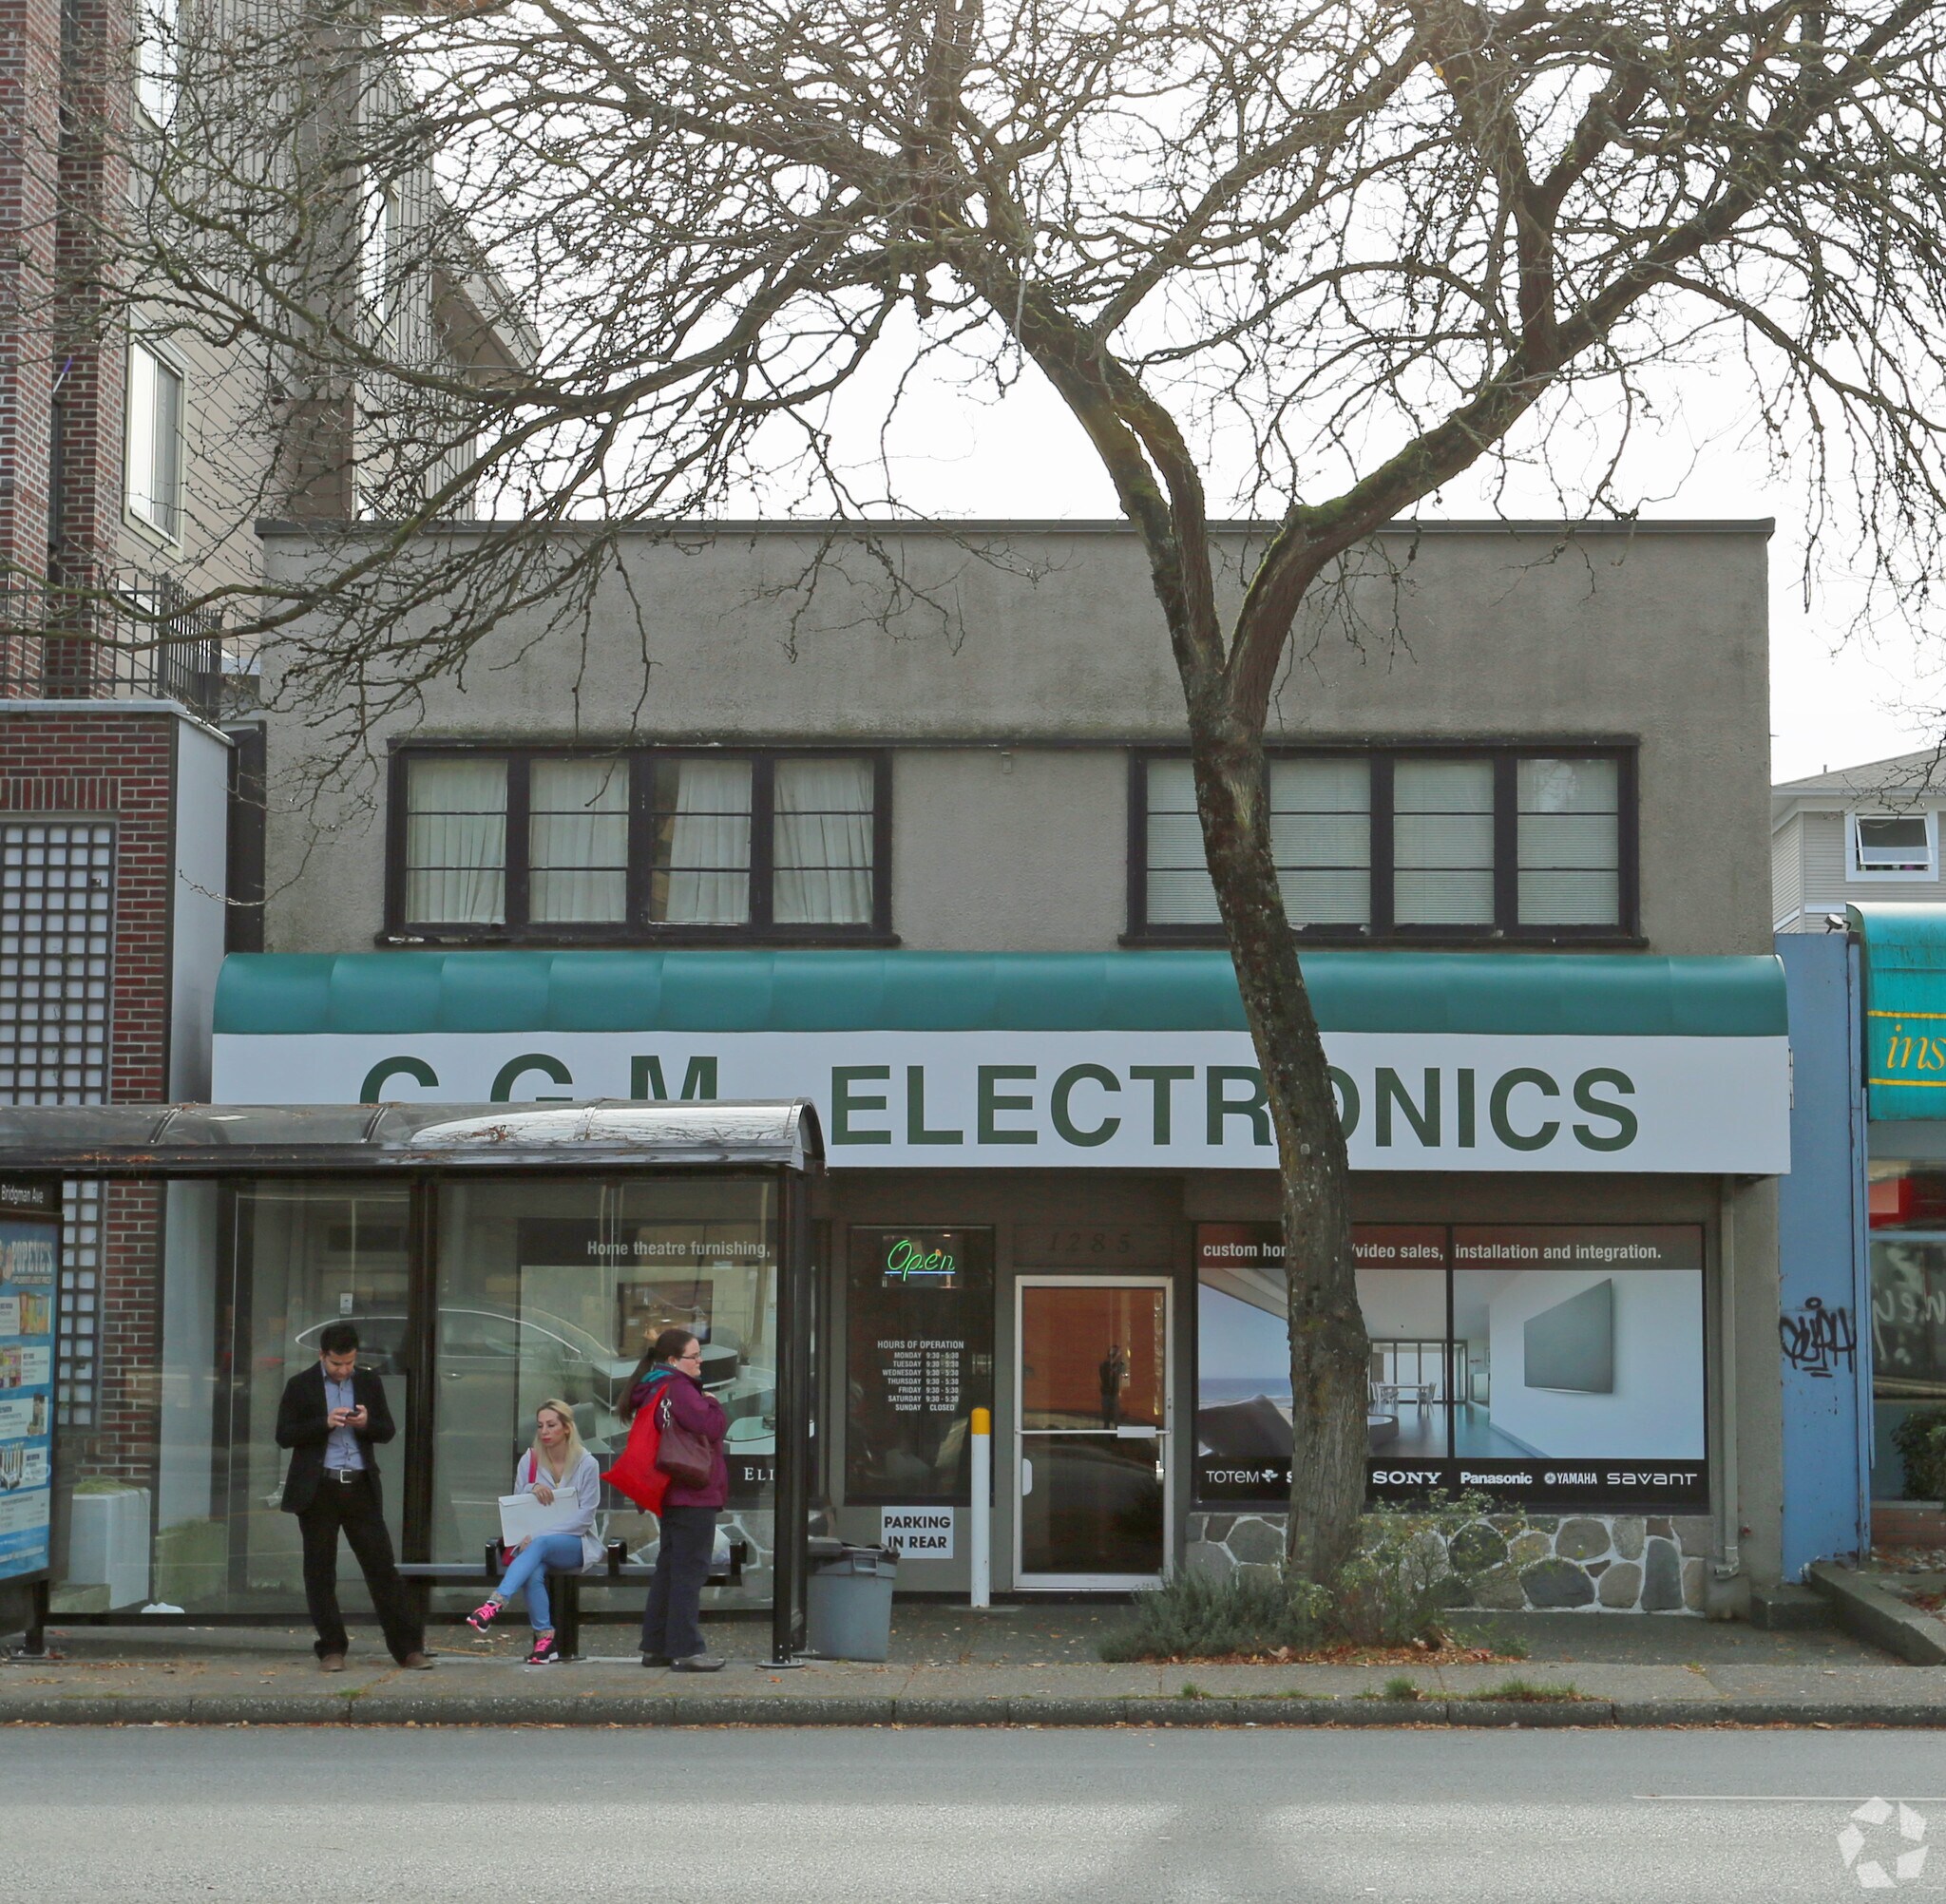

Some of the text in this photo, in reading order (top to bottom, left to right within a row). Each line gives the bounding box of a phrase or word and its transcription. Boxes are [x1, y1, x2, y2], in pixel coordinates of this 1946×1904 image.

[586, 1241, 771, 1259] Home theatre furnishing,
[1203, 1243, 1258, 1258] custom
[1400, 1244, 1444, 1262] sales,
[1455, 1244, 1538, 1259] installation
[1543, 1244, 1571, 1260] and
[1575, 1244, 1662, 1263] integration.
[887, 1239, 956, 1283] Open
[877, 1340, 964, 1349] HOURS OF OPERATION
[743, 1467, 774, 1481] ELI
[1372, 1471, 1442, 1484] SONY
[1460, 1472, 1533, 1485] Panasonic
[1556, 1472, 1598, 1485] YAMAHA
[884, 1515, 951, 1529] PARKING
[887, 1535, 947, 1549] IN REAR
